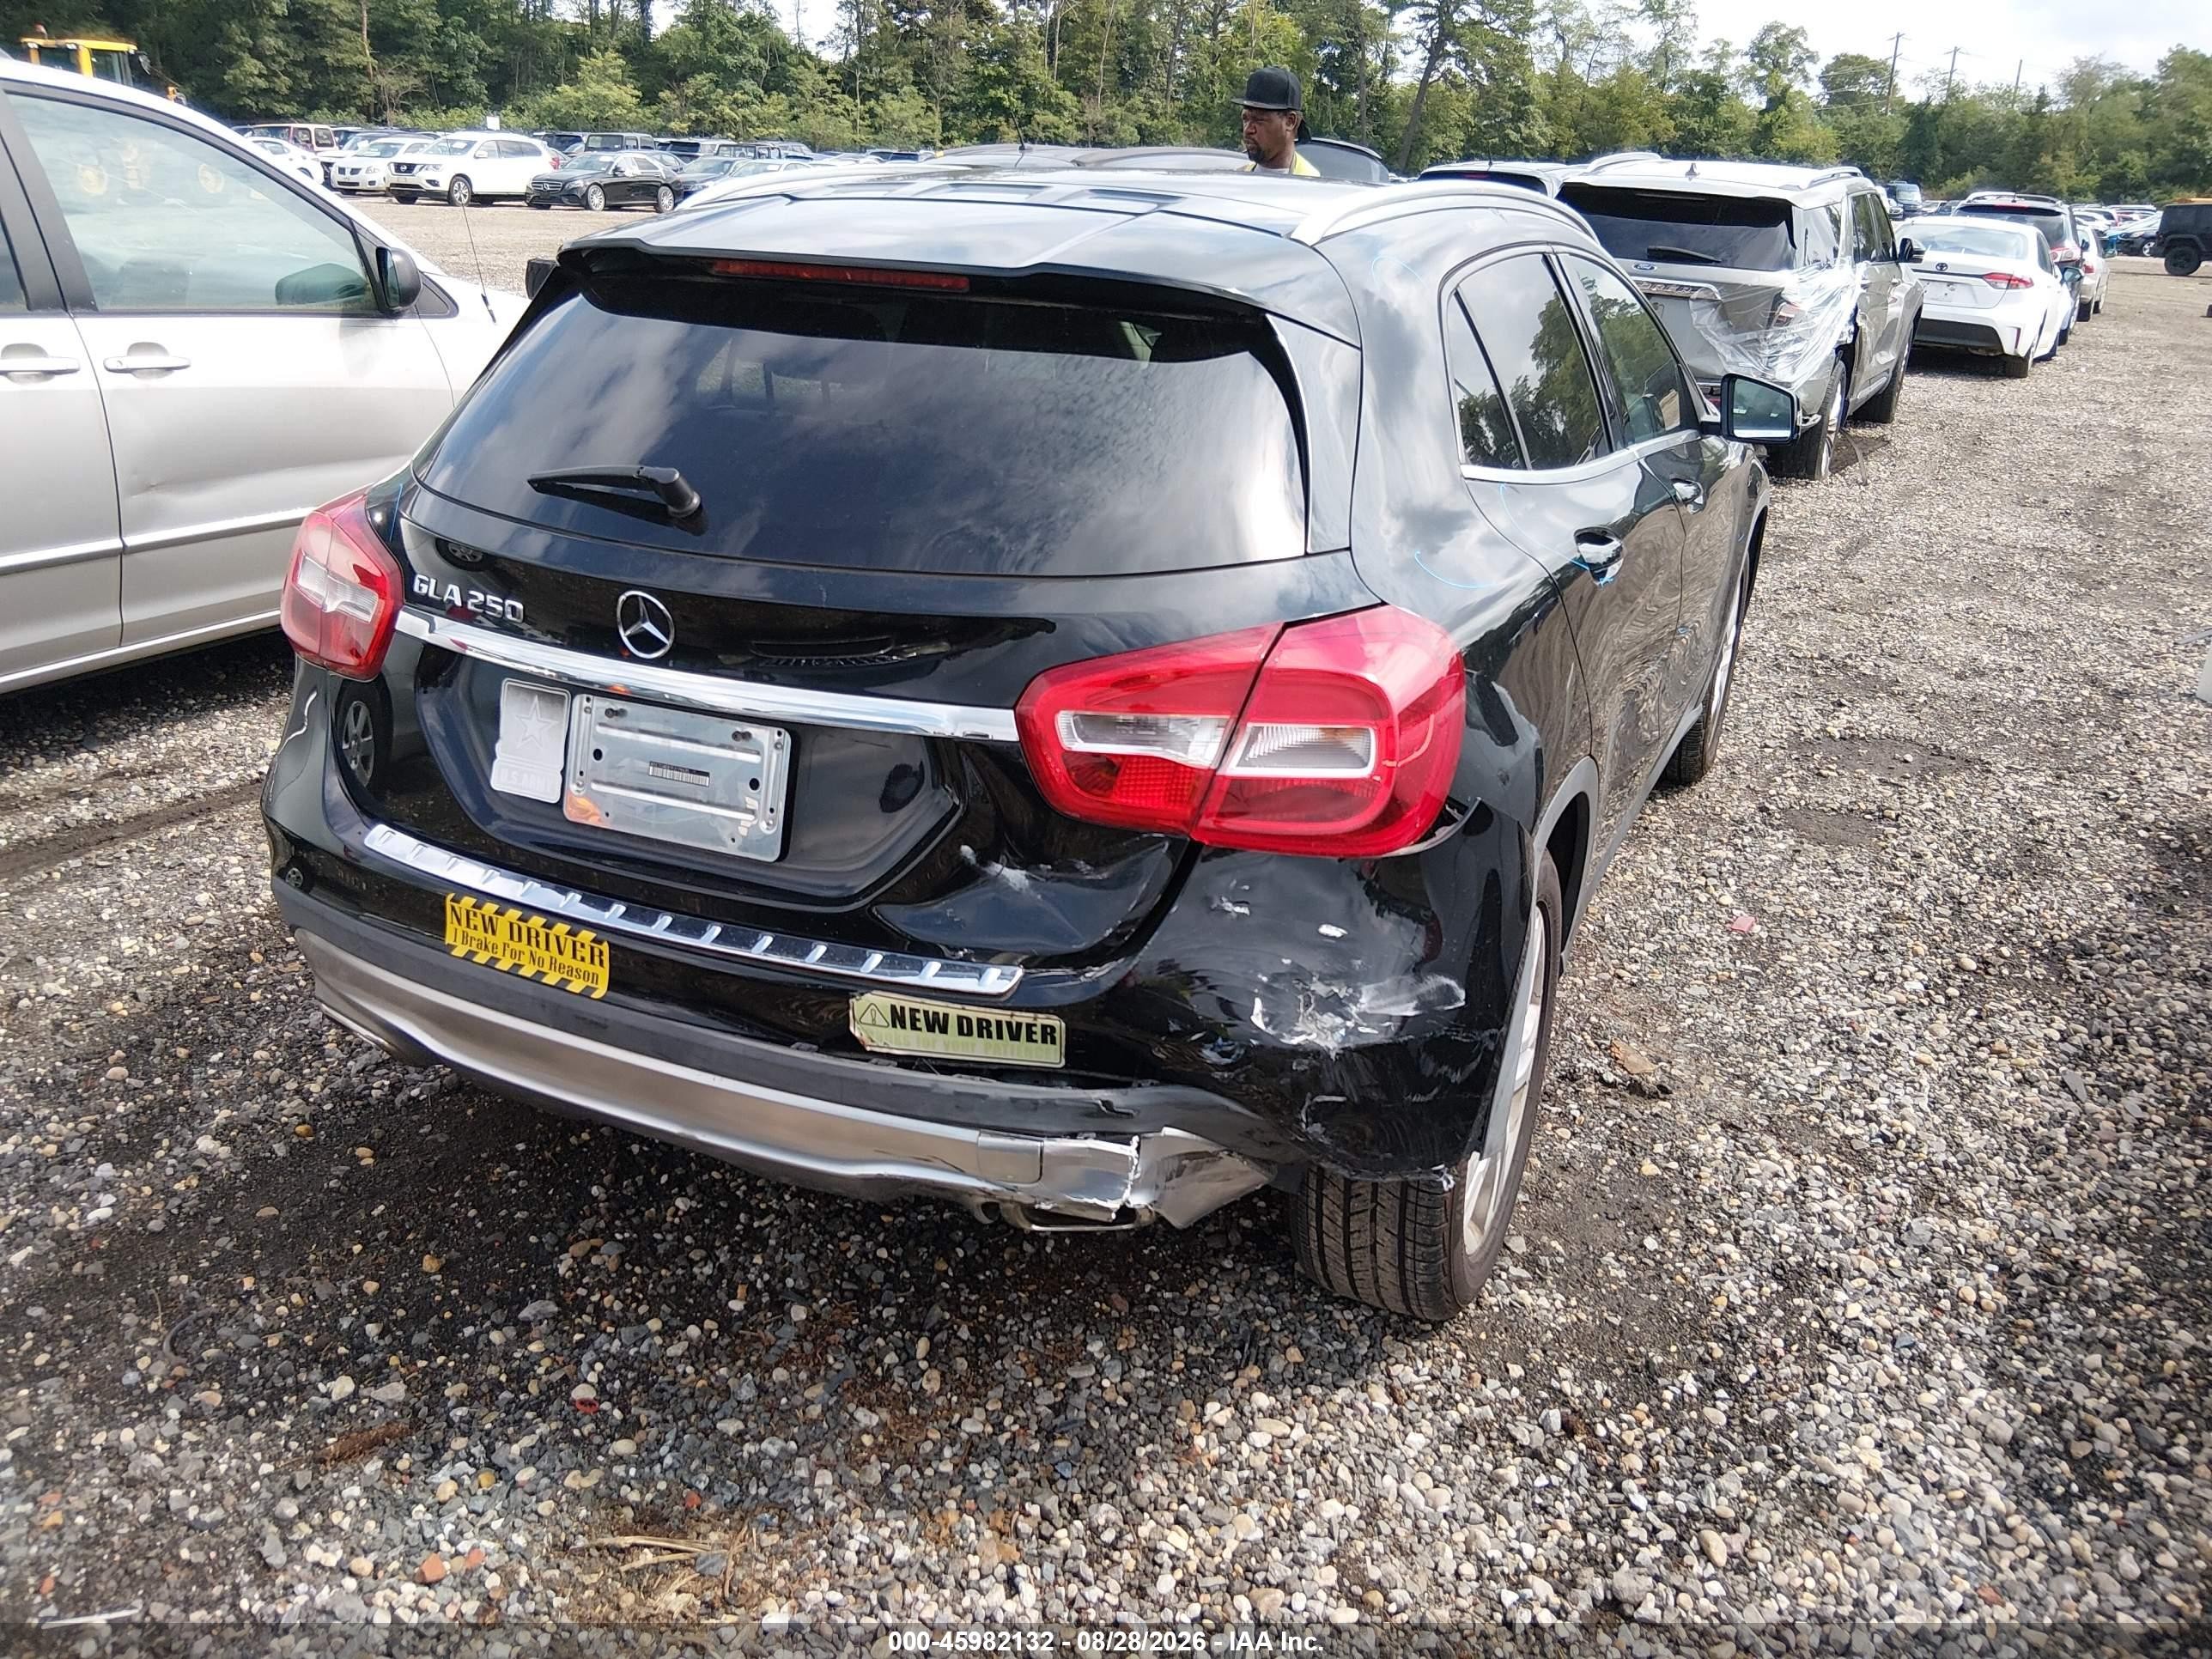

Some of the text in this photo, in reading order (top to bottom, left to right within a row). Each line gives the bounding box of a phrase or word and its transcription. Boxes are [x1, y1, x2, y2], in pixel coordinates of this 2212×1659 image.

[413, 574, 524, 623] GLA 250
[451, 904, 605, 969] NEW DRIVER
[453, 928, 599, 985] I Brake For No Reason
[890, 1003, 1057, 1045] NEW DRIVER
